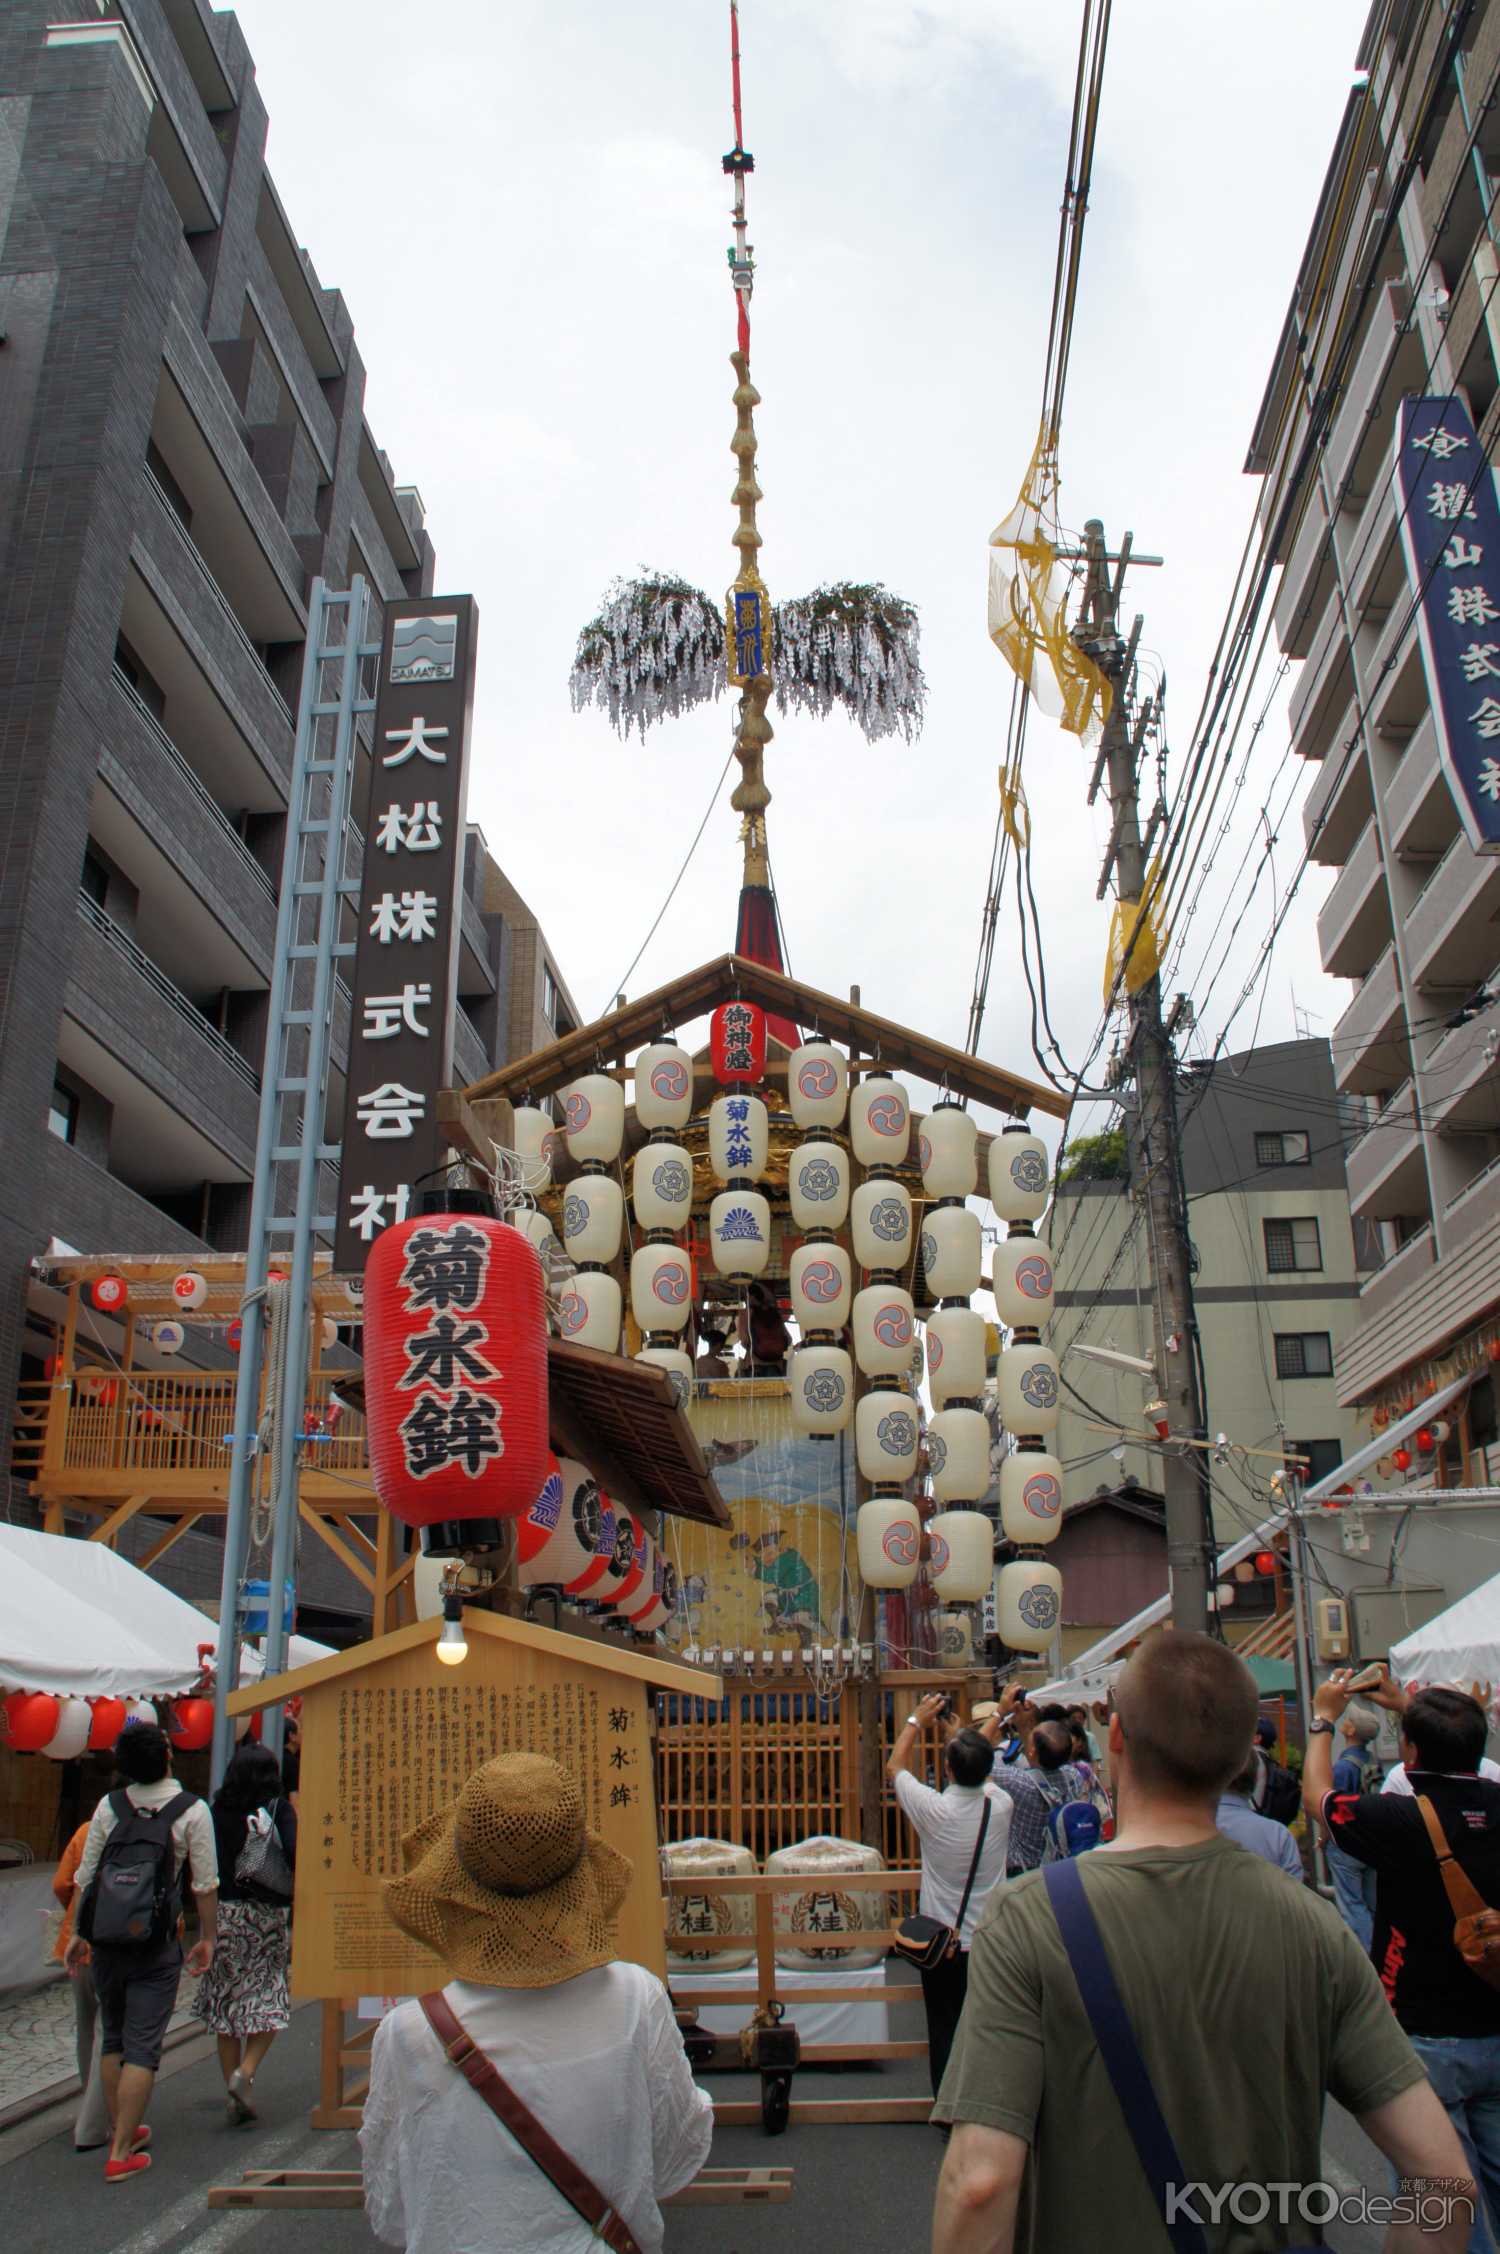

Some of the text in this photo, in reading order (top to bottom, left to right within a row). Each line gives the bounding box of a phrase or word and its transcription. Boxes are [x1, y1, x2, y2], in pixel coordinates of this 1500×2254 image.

[349, 716, 449, 1242] 大松株式会社
[726, 1099, 753, 1169] 菊水鉾
[396, 1221, 504, 1480] 菊水鉾
[607, 1706, 631, 1809] 菊水鉾
